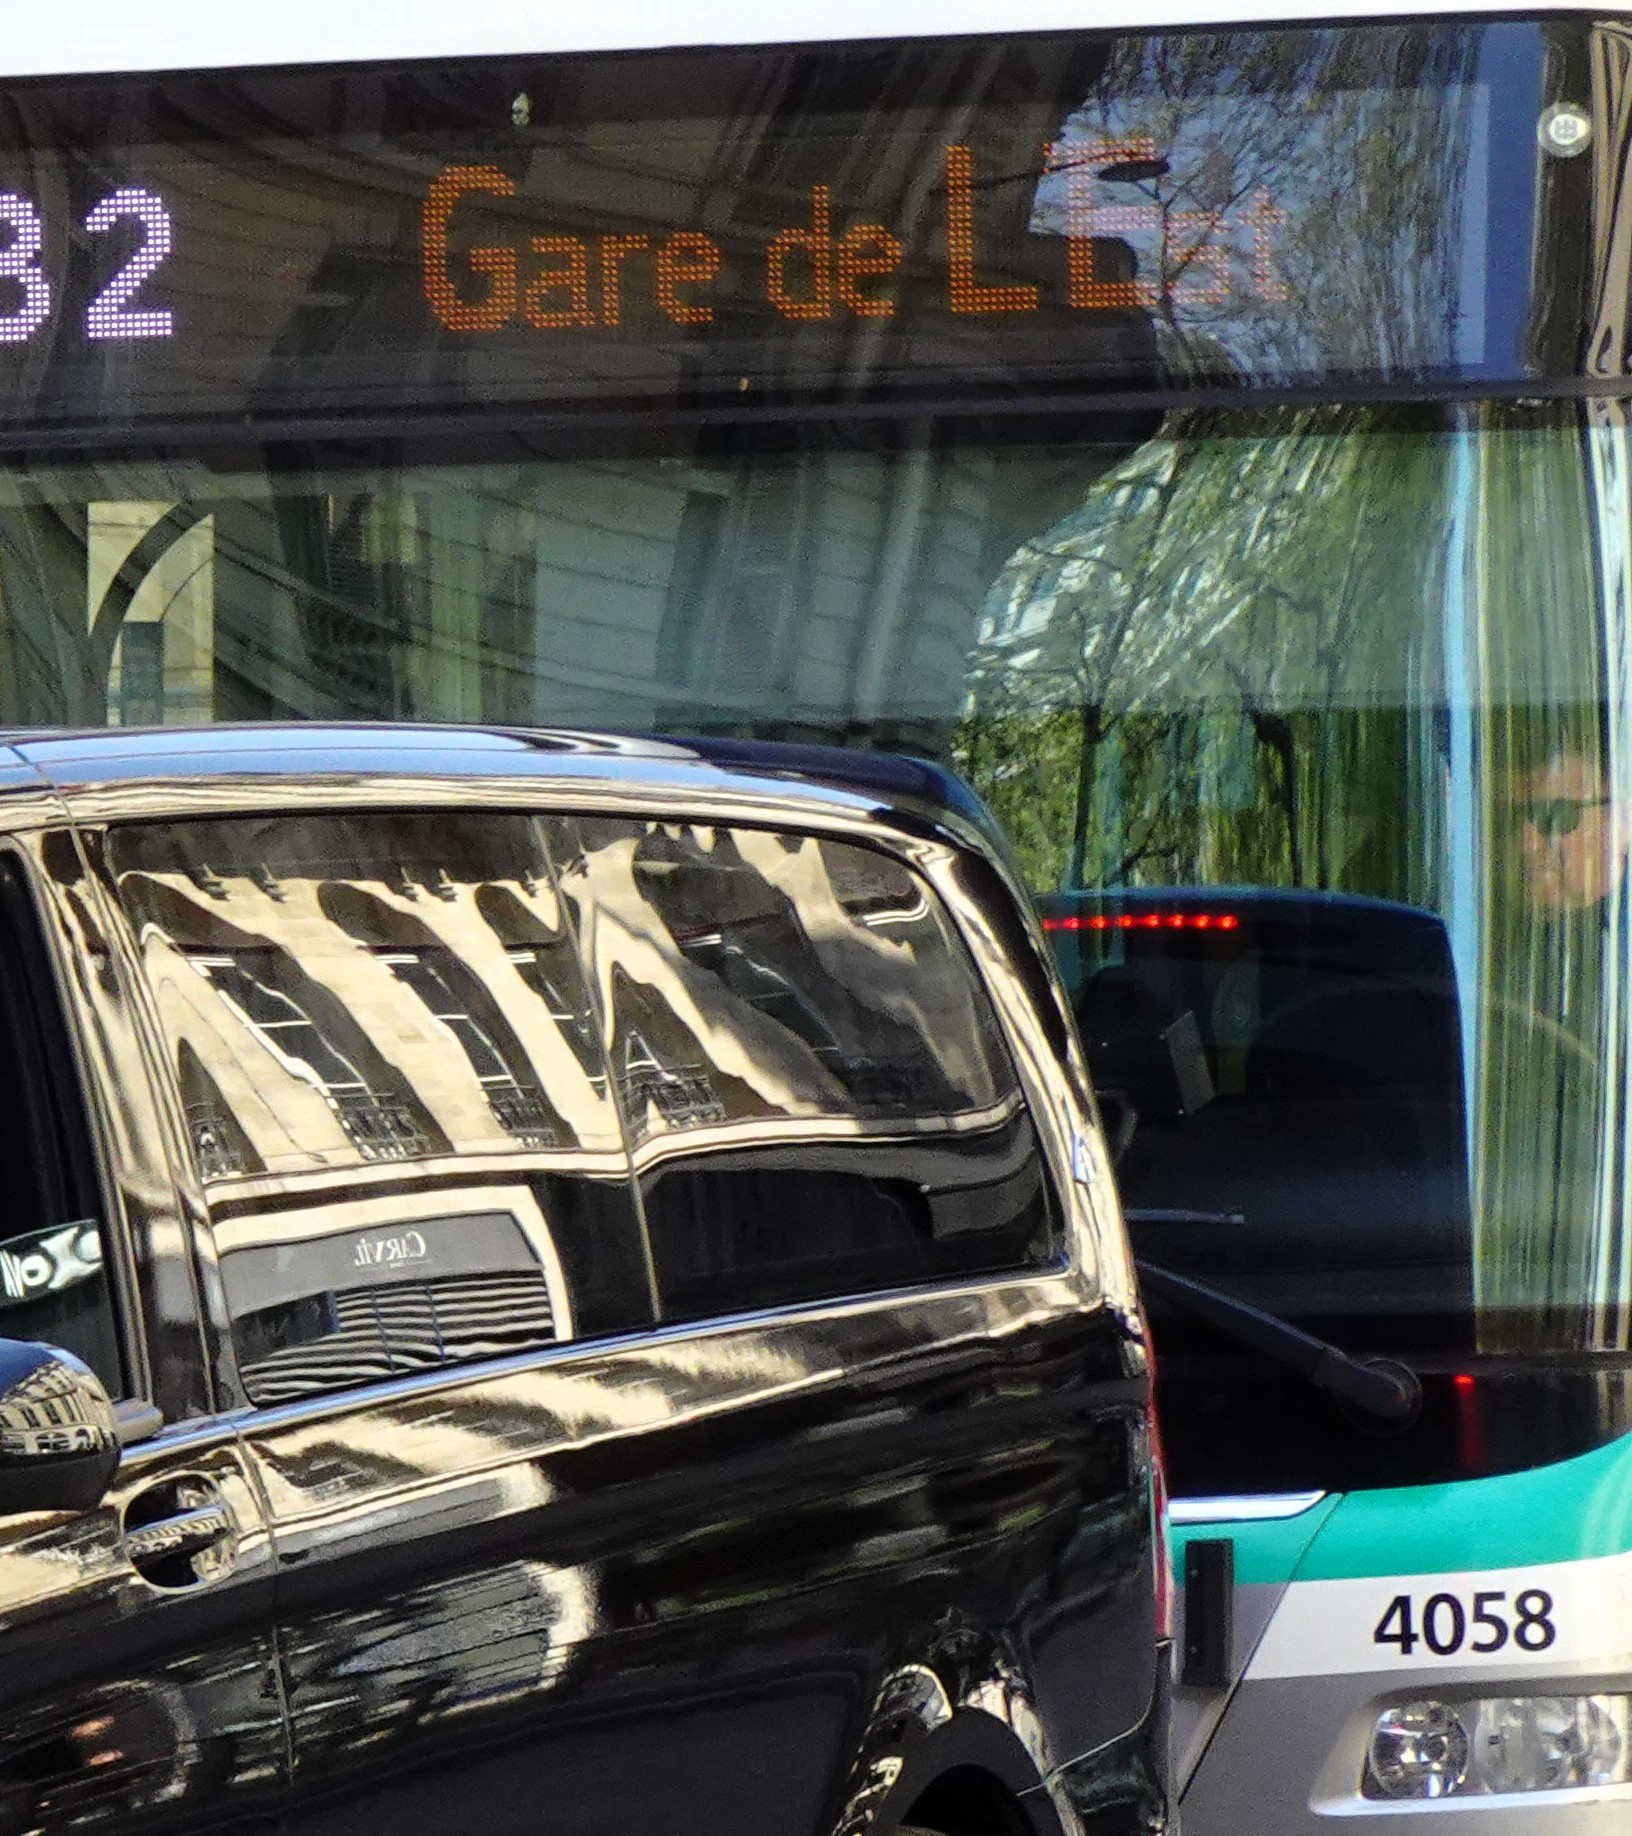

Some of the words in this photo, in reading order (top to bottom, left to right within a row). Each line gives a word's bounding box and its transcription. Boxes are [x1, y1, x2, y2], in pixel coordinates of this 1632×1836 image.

[422, 164, 721, 332] Gare
[764, 184, 904, 319] de
[1373, 1588, 1557, 1656] 4058
